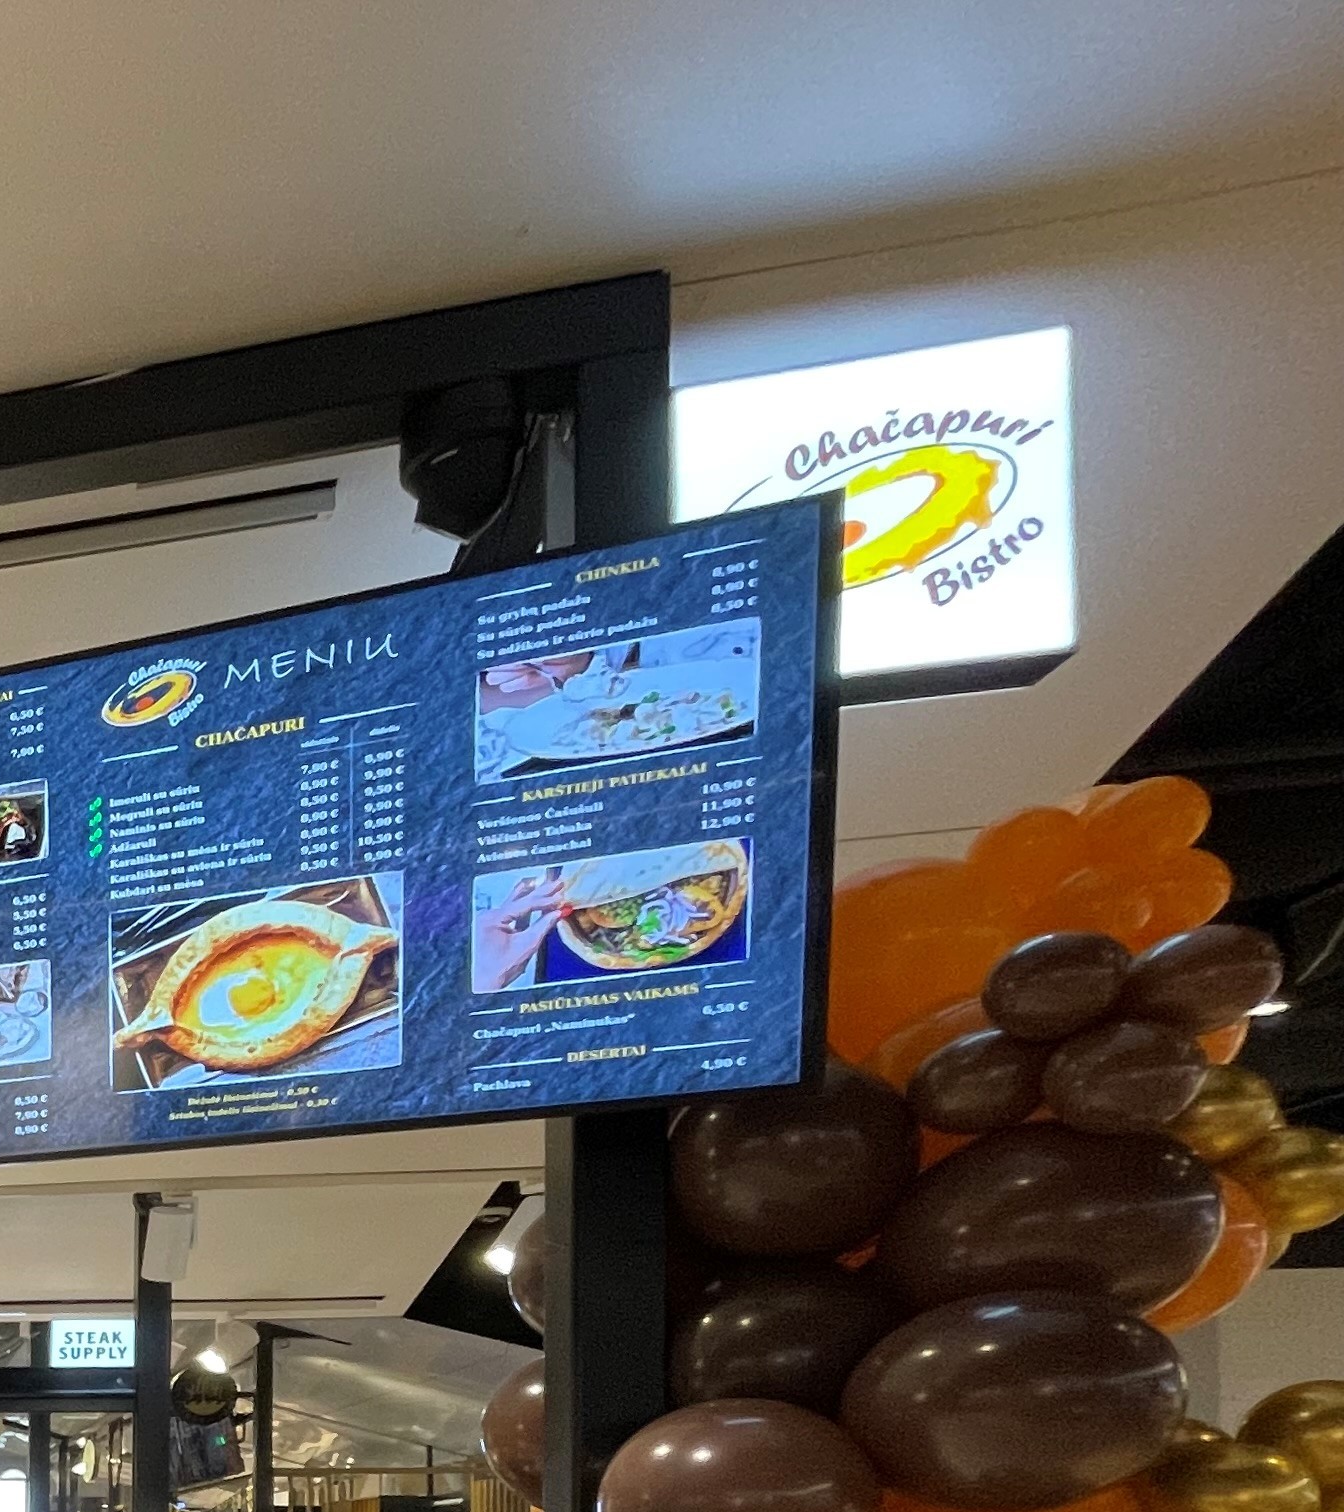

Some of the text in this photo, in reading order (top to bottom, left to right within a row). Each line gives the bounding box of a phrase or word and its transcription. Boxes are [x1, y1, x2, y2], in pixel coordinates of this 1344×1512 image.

[784, 408, 1054, 481] Chačapuri
[748, 560, 759, 570] €
[921, 516, 1044, 606] Bistro
[748, 578, 758, 588] €
[748, 596, 758, 606] €
[478, 616, 494, 626] Su
[542, 596, 590, 614] padažu
[477, 633, 494, 642] Su
[536, 614, 585, 632] padažu
[476, 650, 494, 660] Su
[552, 636, 562, 644] ir
[608, 617, 658, 636] padažu
[224, 634, 399, 688] MENIU
[35, 707, 44, 716] €
[36, 723, 44, 731] €
[195, 717, 305, 748] CHAČAPURI
[36, 745, 44, 754] €
[331, 759, 339, 769] €
[395, 749, 404, 758] €
[331, 765, 404, 785] € €
[610, 762, 708, 788] PATIEKALAI
[746, 778, 756, 787] €
[153, 791, 166, 800] su
[331, 782, 404, 802] € €
[745, 796, 754, 805] €
[156, 806, 170, 815] su
[331, 798, 404, 818] € €
[744, 813, 754, 822] €
[158, 822, 172, 830] su
[331, 814, 404, 834] € €
[331, 841, 339, 850] €
[395, 831, 404, 840] €
[171, 851, 185, 859] su
[220, 843, 230, 852] ir
[331, 847, 404, 866] € €
[171, 866, 185, 875] su
[227, 858, 237, 866] ir
[157, 883, 171, 892] su
[39, 893, 46, 902] €
[39, 908, 46, 916] €
[39, 923, 46, 932] €
[39, 938, 46, 946] €
[624, 983, 700, 1001] VAIKAMS
[738, 1001, 749, 1012] €
[568, 1045, 646, 1062] DESERTAI
[737, 1056, 746, 1066] €
[41, 1094, 48, 1103] €
[41, 1109, 48, 1118] €
[41, 1124, 48, 1133] €
[64, 1332, 122, 1344] STEAK
[59, 1347, 127, 1359] SUPPLY
